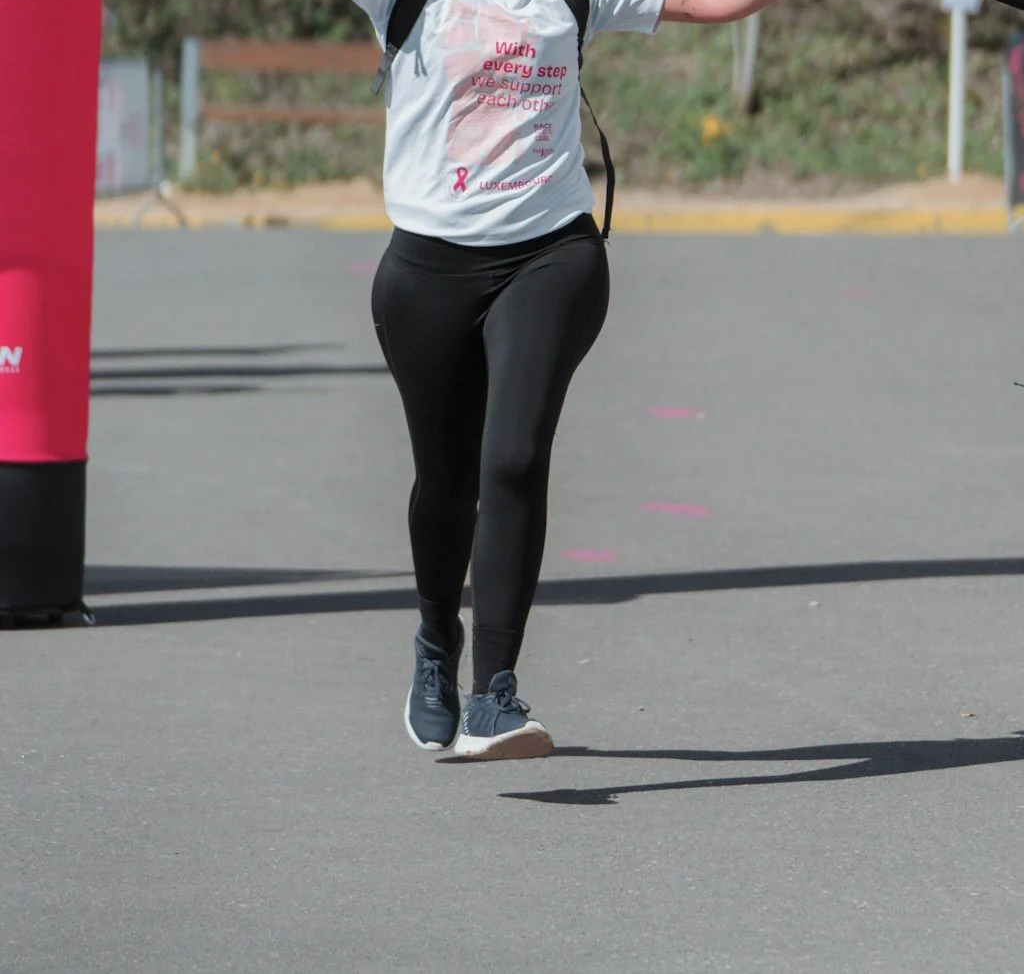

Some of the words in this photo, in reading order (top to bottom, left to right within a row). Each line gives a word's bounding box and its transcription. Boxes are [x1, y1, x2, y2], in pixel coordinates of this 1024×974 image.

[495, 41, 536, 58] With
[483, 60, 533, 78] every
[537, 65, 567, 79] step
[471, 75, 496, 88] we
[500, 79, 563, 95] support
[477, 93, 517, 108] each
